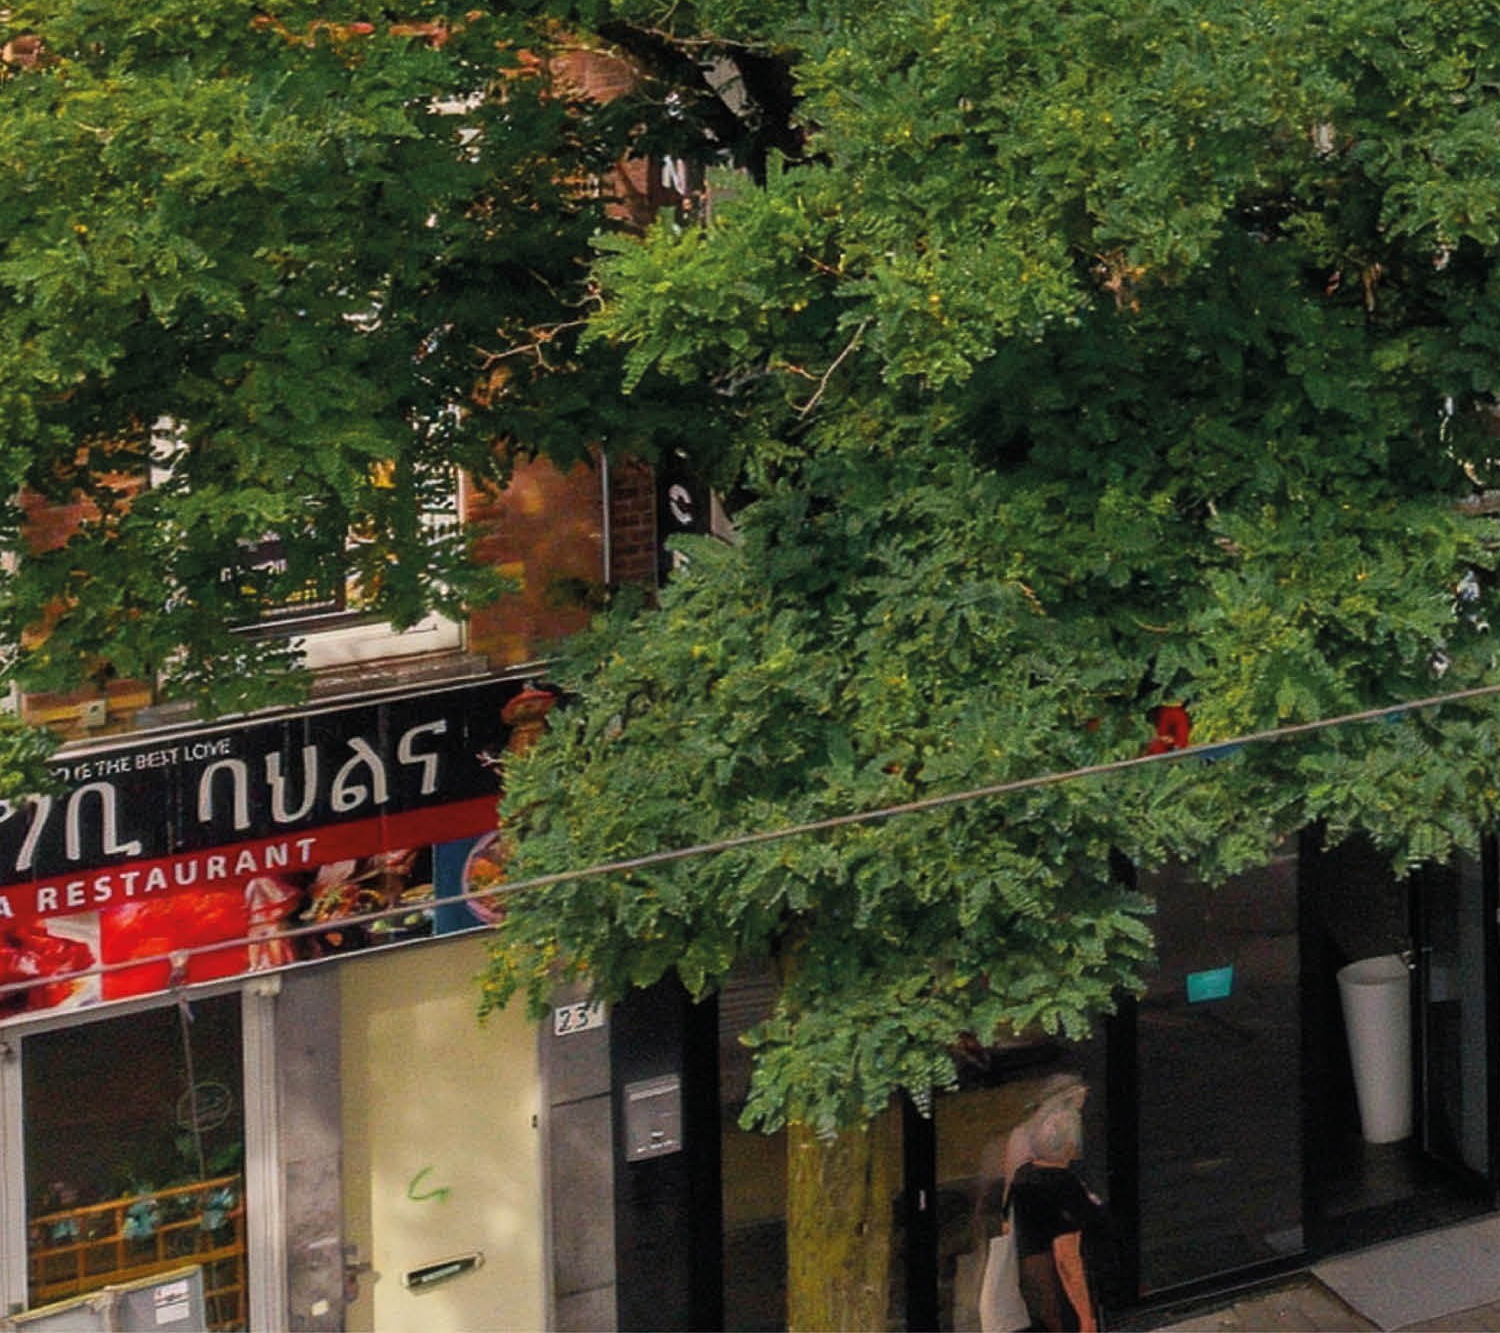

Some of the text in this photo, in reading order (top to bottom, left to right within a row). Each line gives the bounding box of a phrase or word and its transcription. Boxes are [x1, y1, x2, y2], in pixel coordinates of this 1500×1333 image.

[95, 755, 132, 777] THE
[135, 746, 179, 771] BEST
[184, 737, 232, 762] LOVE
[36, 837, 317, 914] RESTAURANT
